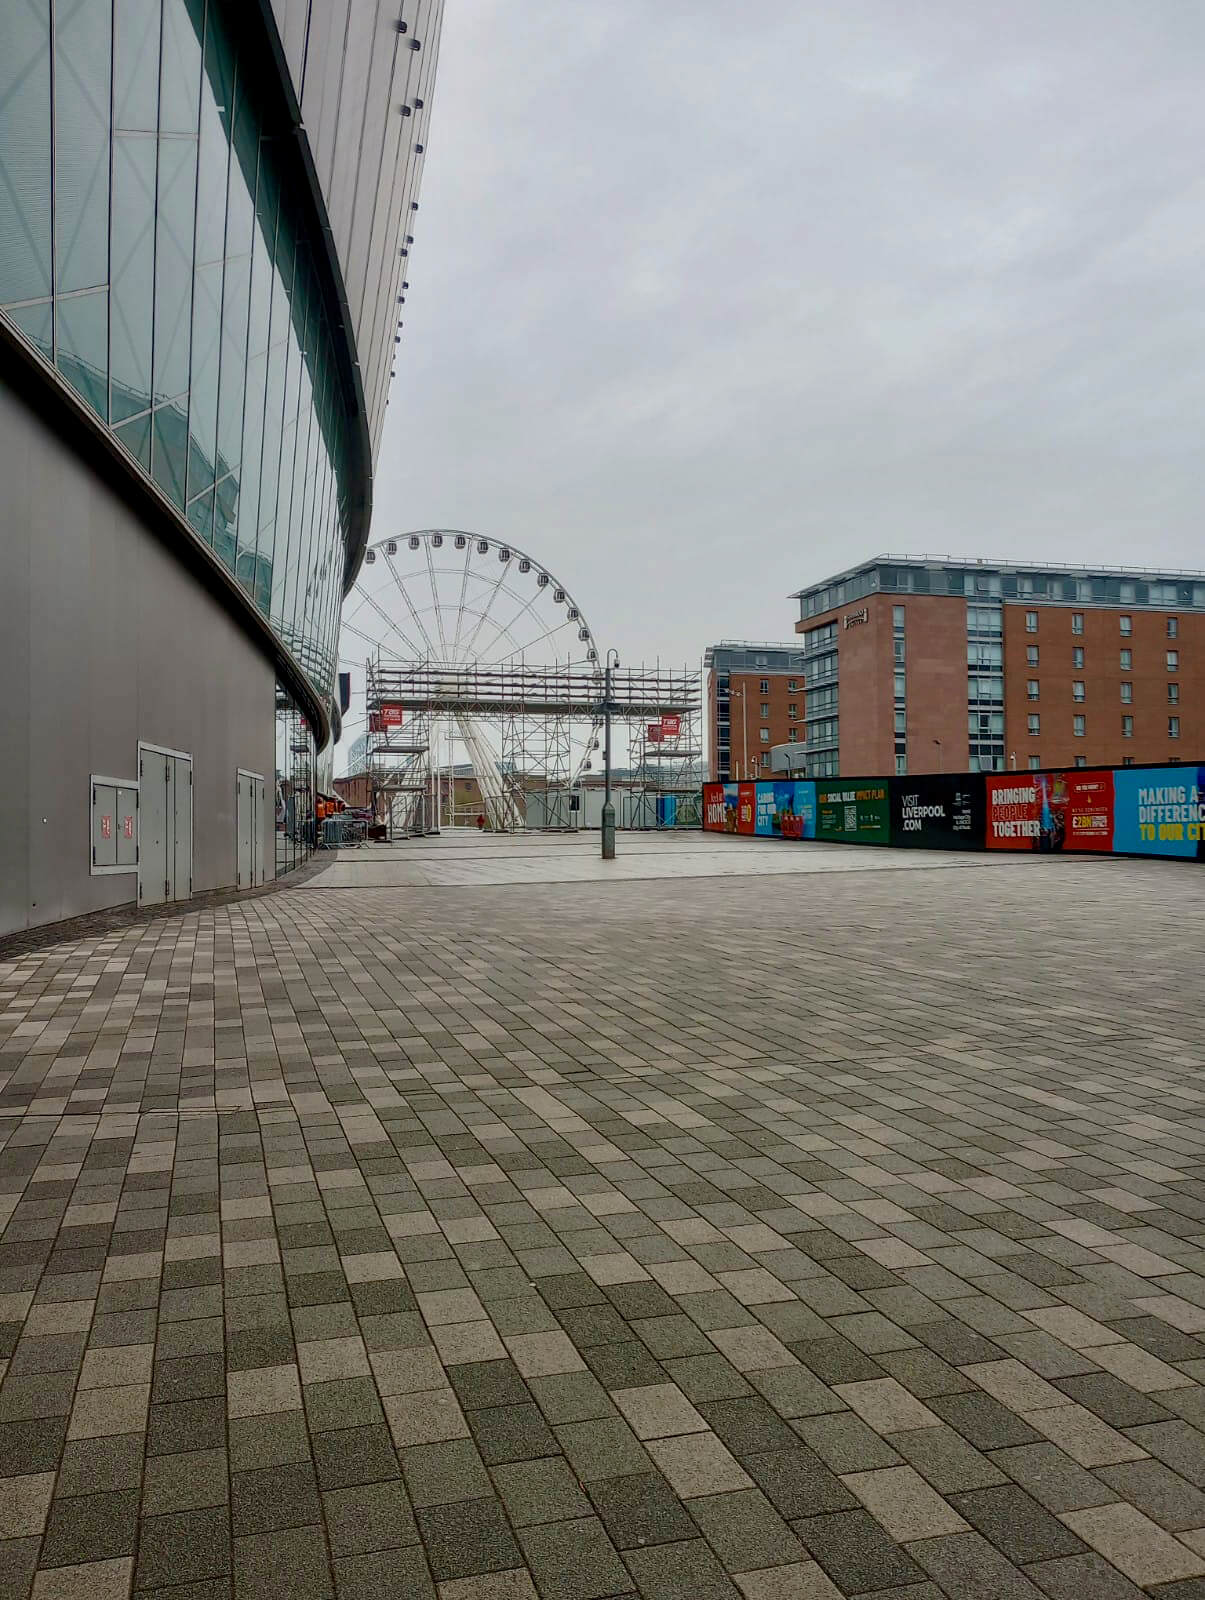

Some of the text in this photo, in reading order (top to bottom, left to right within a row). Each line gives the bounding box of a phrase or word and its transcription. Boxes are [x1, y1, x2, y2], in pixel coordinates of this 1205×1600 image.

[901, 794, 920, 807] VISIT
[992, 787, 1036, 805] BRINGING
[1138, 785, 1199, 805] MAKING A
[707, 802, 728, 824] HOME
[902, 805, 946, 819] LIVERPOOL
[992, 804, 1028, 821] PEOPLE
[992, 820, 1041, 838] TOGETHER
[1139, 823, 1155, 841] TO
[1159, 823, 1183, 841] OUR
